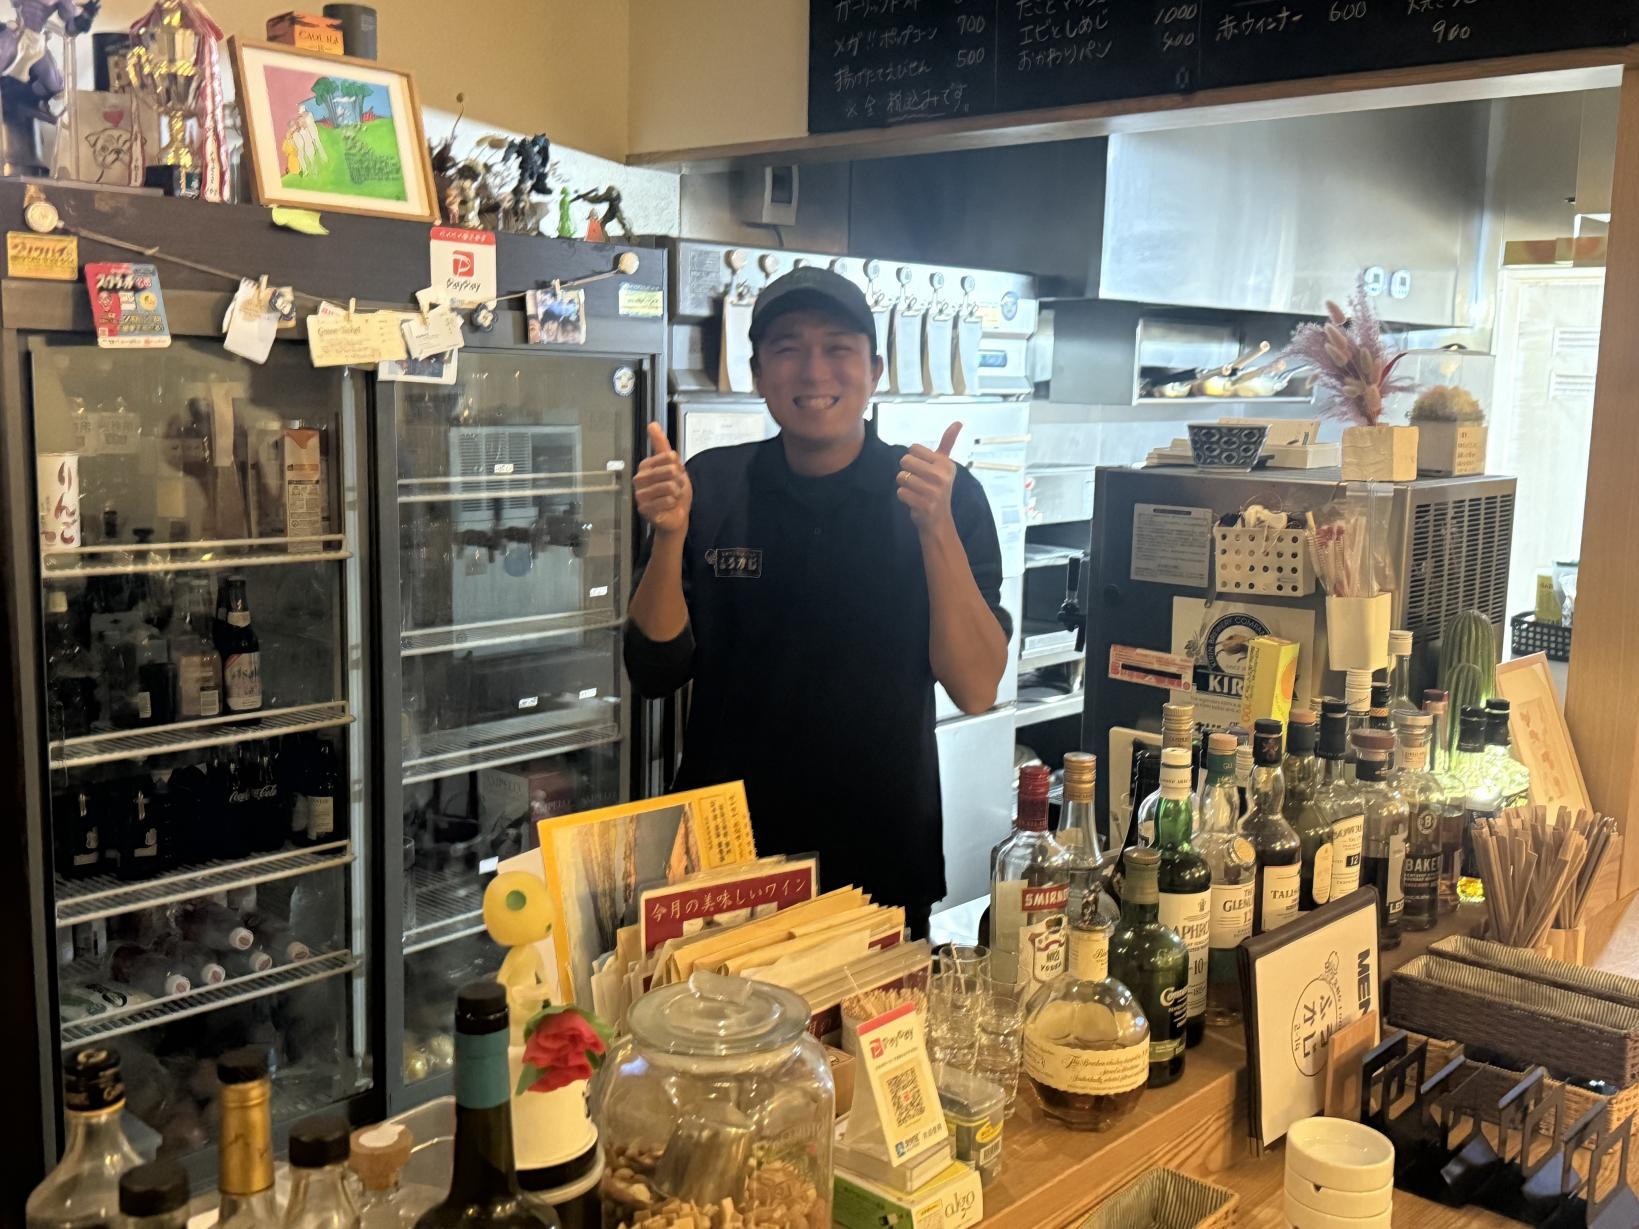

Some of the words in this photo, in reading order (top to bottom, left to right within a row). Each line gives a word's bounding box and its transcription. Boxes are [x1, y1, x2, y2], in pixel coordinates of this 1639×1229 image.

[956, 15, 986, 35] 700
[1154, 4, 1198, 25] 1000
[1215, 6, 1304, 41] 赤ウィンナー
[1329, 1, 1367, 22] 600
[1018, 9, 1110, 46] エビとしめじ
[1432, 20, 1471, 43] 900
[956, 47, 985, 68] 500
[1018, 39, 1113, 72] おかわりパン
[55, 461, 78, 545] りんご
[1350, 854, 1359, 866] 12
[652, 879, 806, 922] 今月の美味しいワイン
[1194, 958, 1204, 976] 10
